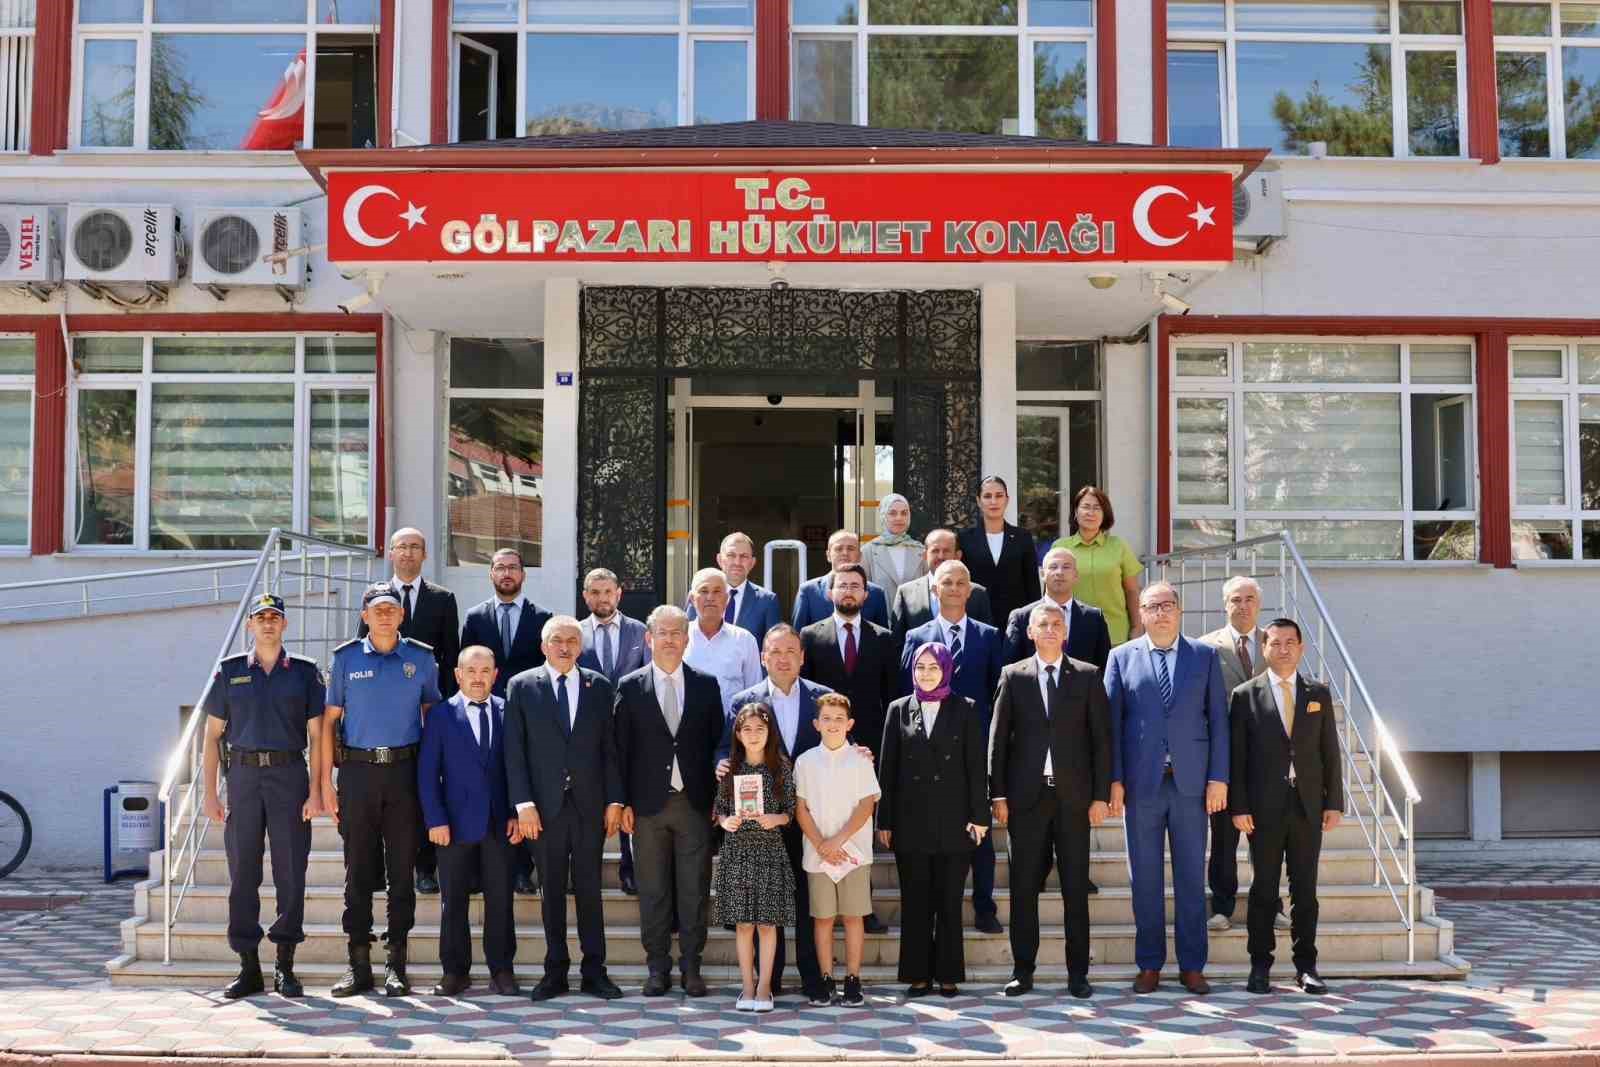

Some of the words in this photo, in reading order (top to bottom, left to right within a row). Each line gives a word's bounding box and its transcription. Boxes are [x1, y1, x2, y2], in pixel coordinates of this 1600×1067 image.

[735, 178, 826, 210] T.C.
[20, 215, 34, 270] VESTEL
[144, 208, 159, 257] arçelik
[273, 212, 288, 255] rçelik
[440, 213, 692, 254] GÖLPAZARI
[709, 214, 931, 254] HÜKÜMET
[944, 213, 1116, 254] KONAĞI
